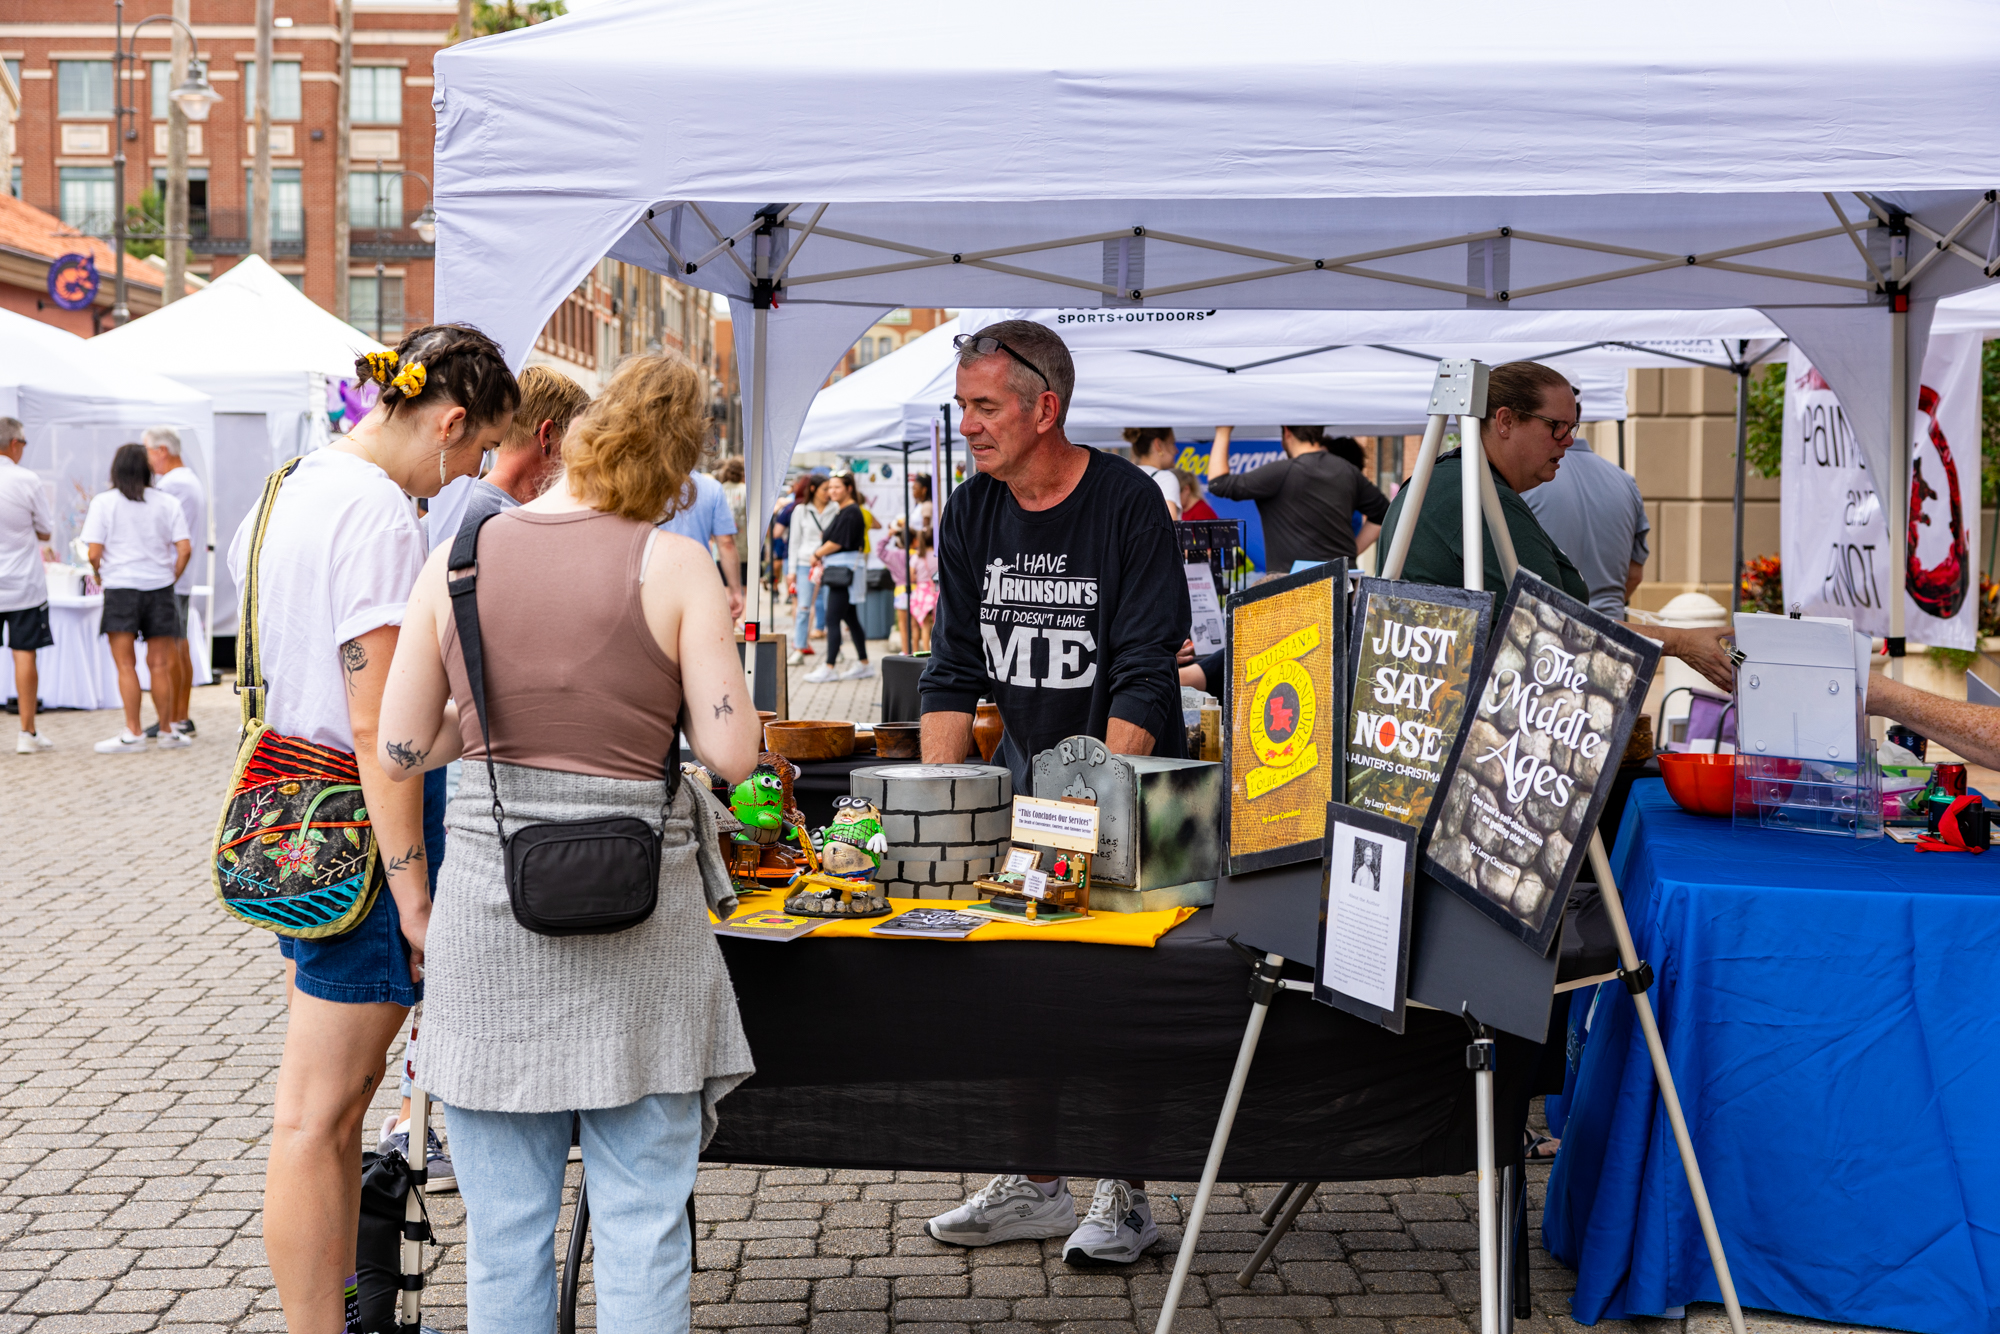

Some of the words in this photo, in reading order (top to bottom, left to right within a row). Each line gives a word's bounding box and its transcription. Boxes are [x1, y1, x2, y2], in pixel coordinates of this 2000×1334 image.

[1058, 311, 1205, 323] SPORTS+OUTDOORS
[1015, 553, 1020, 571] I
[1024, 553, 1067, 574] HAVE
[980, 607, 999, 621] BUT
[1001, 610, 1011, 622] IT
[1012, 610, 1054, 625] DOESN'T
[1057, 614, 1086, 628] HAVE
[980, 622, 1097, 690] ME
[1249, 631, 1314, 675] LOUISIANA
[1372, 620, 1458, 665] JUST
[1534, 644, 1588, 694] The
[1277, 664, 1313, 748] ADVENTURE
[1373, 667, 1446, 711] SAY
[1486, 669, 1601, 759] Middle
[1058, 737, 1106, 767] RIP
[1352, 710, 1443, 763] NOSE
[1351, 753, 1394, 772] HUNTER'S
[1476, 729, 1575, 808] Ages
[1032, 810, 1057, 822] Concludes
[1057, 814, 1068, 823] Our
[1364, 797, 1371, 807] by
[1371, 799, 1386, 811] Larry
[1385, 802, 1410, 816] Crawford
[1471, 793, 1484, 807] One
[1482, 802, 1500, 818] man's
[1481, 815, 1490, 825] on
[1489, 820, 1510, 839] getting
[1509, 833, 1525, 847] older
[1469, 841, 1477, 853] by
[1476, 847, 1491, 862] Larry
[1490, 856, 1515, 878] Crawford
